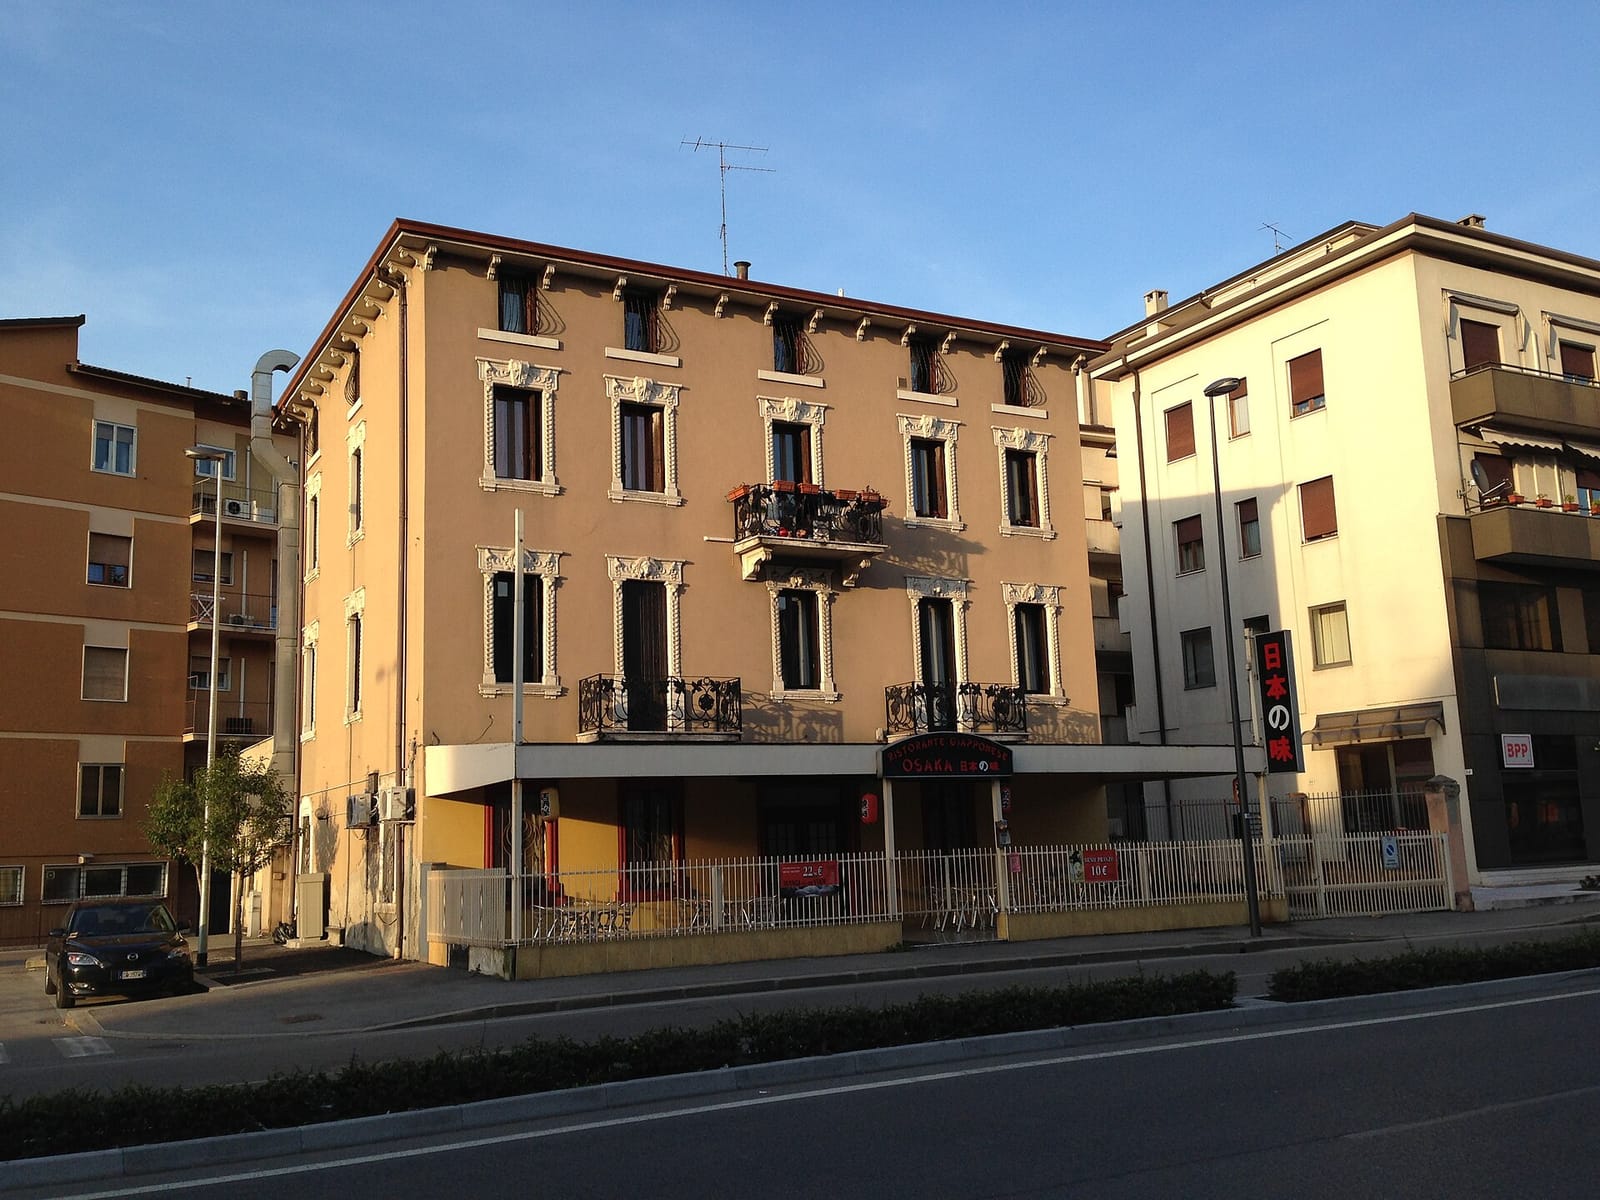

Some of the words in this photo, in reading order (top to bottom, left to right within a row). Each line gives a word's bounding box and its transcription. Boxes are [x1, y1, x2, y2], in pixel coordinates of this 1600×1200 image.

[1263, 642, 1294, 762] 日本の味
[888, 738, 945, 760] RISTORANTE
[1506, 743, 1528, 758] BPP
[902, 759, 953, 772] OSAKA
